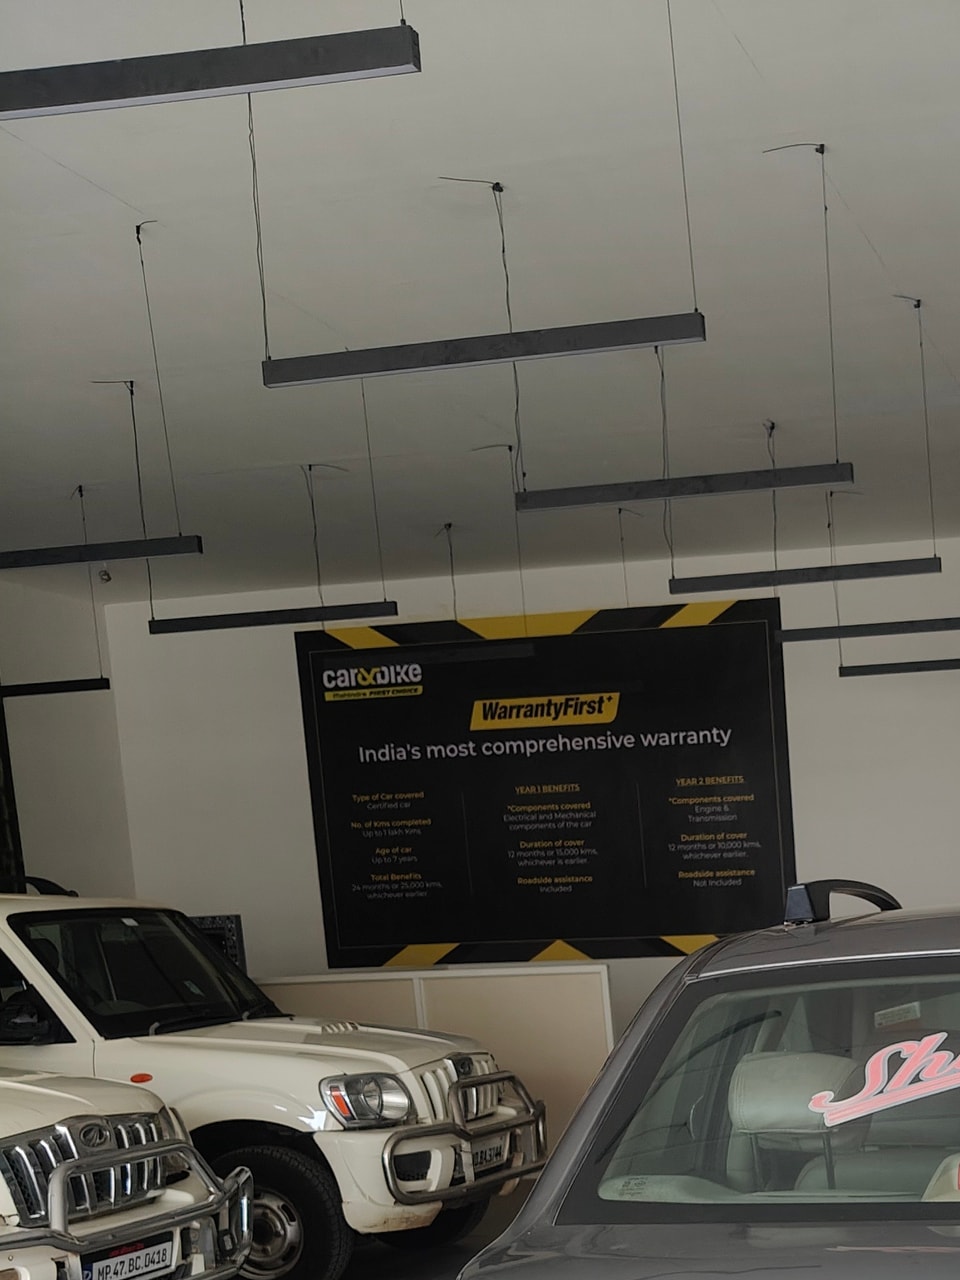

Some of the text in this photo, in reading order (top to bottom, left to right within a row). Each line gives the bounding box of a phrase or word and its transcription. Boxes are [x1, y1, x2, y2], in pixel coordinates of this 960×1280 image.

[359, 726, 732, 763] India's most comprehensive warranty
[676, 778, 698, 788] YEAR
[704, 776, 745, 786] BENEFITS
[515, 785, 537, 794] YEAR
[542, 783, 581, 793] BENEFITS
[680, 834, 716, 843] Duration
[716, 832, 725, 841] of
[520, 840, 554, 849] Duration
[555, 840, 563, 848] of
